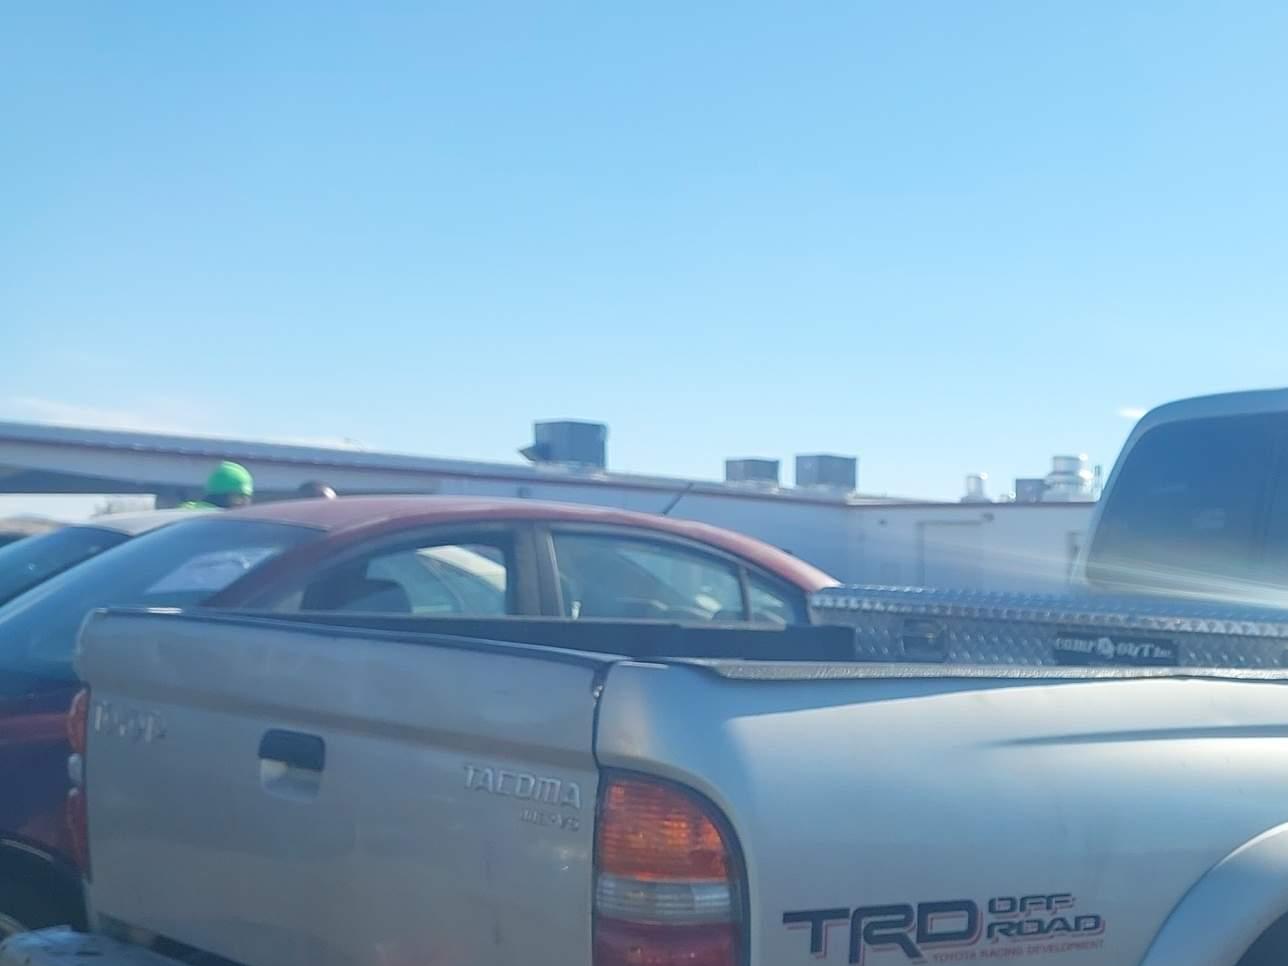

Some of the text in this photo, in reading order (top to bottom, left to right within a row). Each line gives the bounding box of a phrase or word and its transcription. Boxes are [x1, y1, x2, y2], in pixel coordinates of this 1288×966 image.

[463, 764, 582, 809] TACOMA
[987, 892, 1076, 917] OFF
[986, 914, 1106, 942] ROAD
[1026, 940, 1105, 956] DEVELOPMENT
